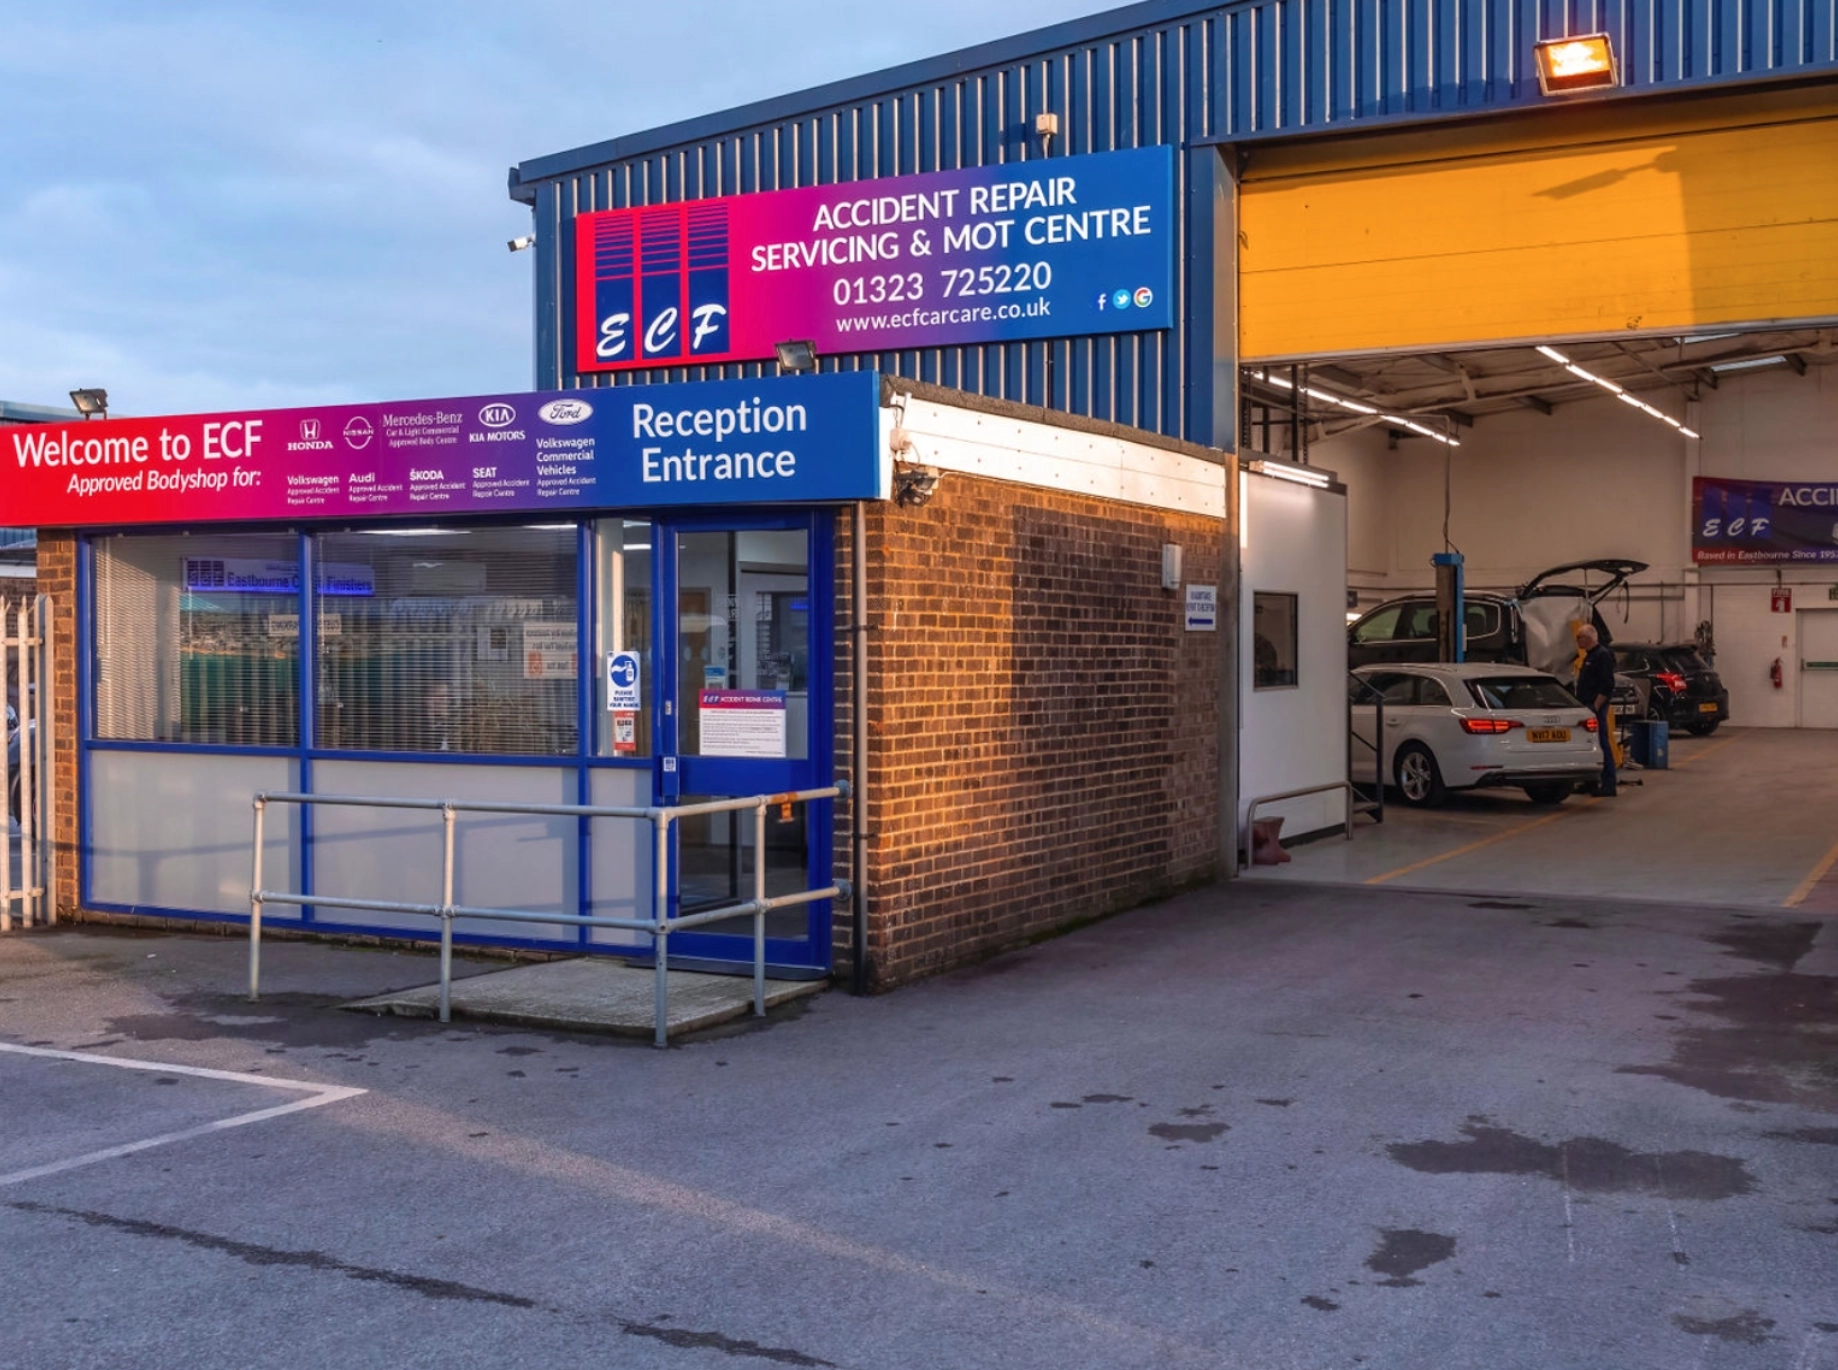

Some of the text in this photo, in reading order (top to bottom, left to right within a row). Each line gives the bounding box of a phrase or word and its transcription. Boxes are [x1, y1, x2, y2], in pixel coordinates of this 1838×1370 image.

[813, 177, 1077, 231] ACCIDENT REPAIR
[751, 205, 1151, 272] SERVICING & MOT CENTRE
[834, 261, 1052, 306] 01323 725220
[836, 297, 1051, 332] www.ecfcarcare.co.uk
[485, 408, 510, 423] KIA
[550, 403, 582, 419] Ford
[382, 411, 464, 427] Mercedes-Benz
[633, 396, 807, 443] Reception
[343, 428, 375, 437] NISSAN
[469, 430, 526, 443] KIA MOTORS
[13, 419, 263, 468] Welcome to ECF
[287, 440, 334, 451] HONDA
[536, 437, 596, 450] Volkswagen
[536, 449, 595, 462] Commercial
[536, 464, 577, 476] Vehicles
[642, 447, 796, 483] Entrance
[348, 472, 376, 483] Audi
[409, 467, 444, 481] ŠKODA
[472, 466, 498, 479] SEAT
[67, 466, 262, 497] Approved Bodyshop for:
[287, 474, 340, 487] Volkswagen
[410, 483, 438, 492] Approved
[537, 478, 567, 488] Approved
[1778, 487, 1838, 507] ACCI
[1697, 550, 1726, 561] Based
[1727, 550, 1736, 560] in
[1738, 550, 1790, 560] Eastbourne
[1792, 550, 1817, 560] Since
[228, 571, 289, 588] Eastbourne
